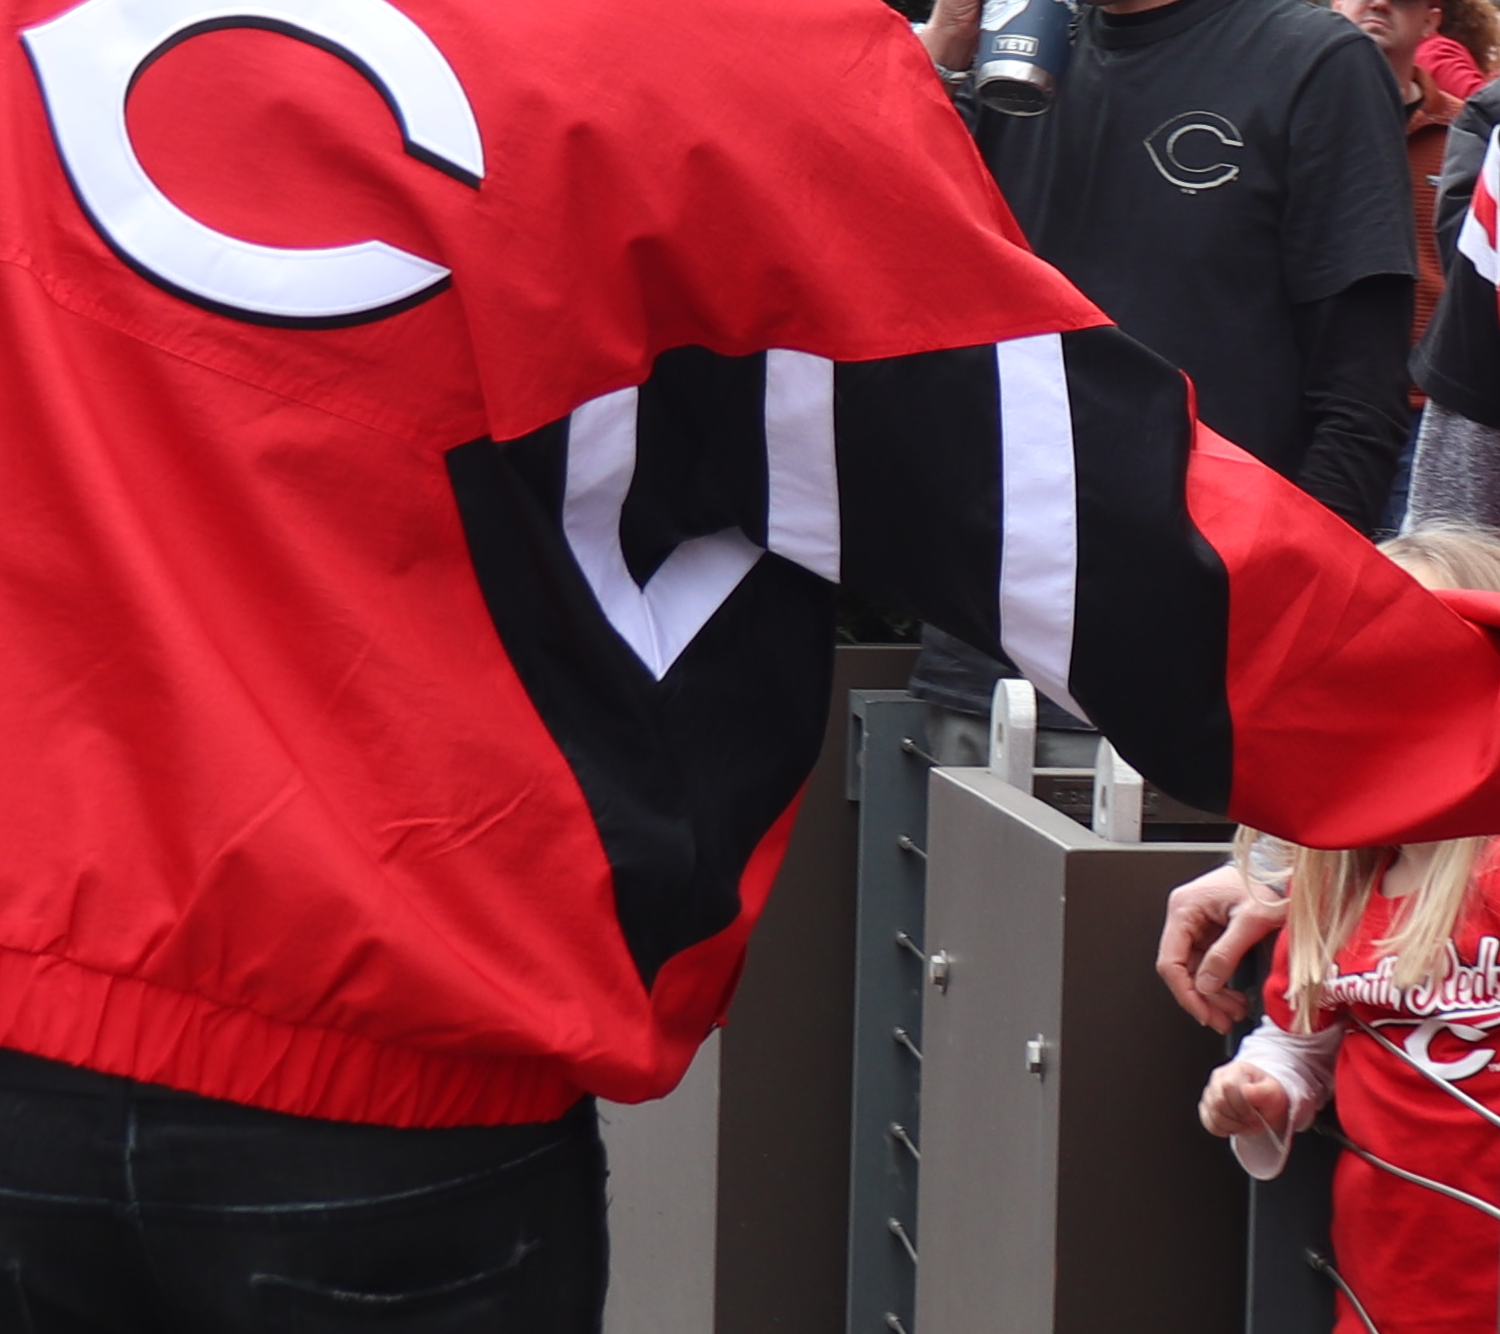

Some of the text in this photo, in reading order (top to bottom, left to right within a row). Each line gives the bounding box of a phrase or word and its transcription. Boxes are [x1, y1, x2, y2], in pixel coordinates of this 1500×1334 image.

[996, 38, 1035, 54] YETI
[1143, 110, 1244, 189] C
[1403, 1019, 1496, 1082] C
